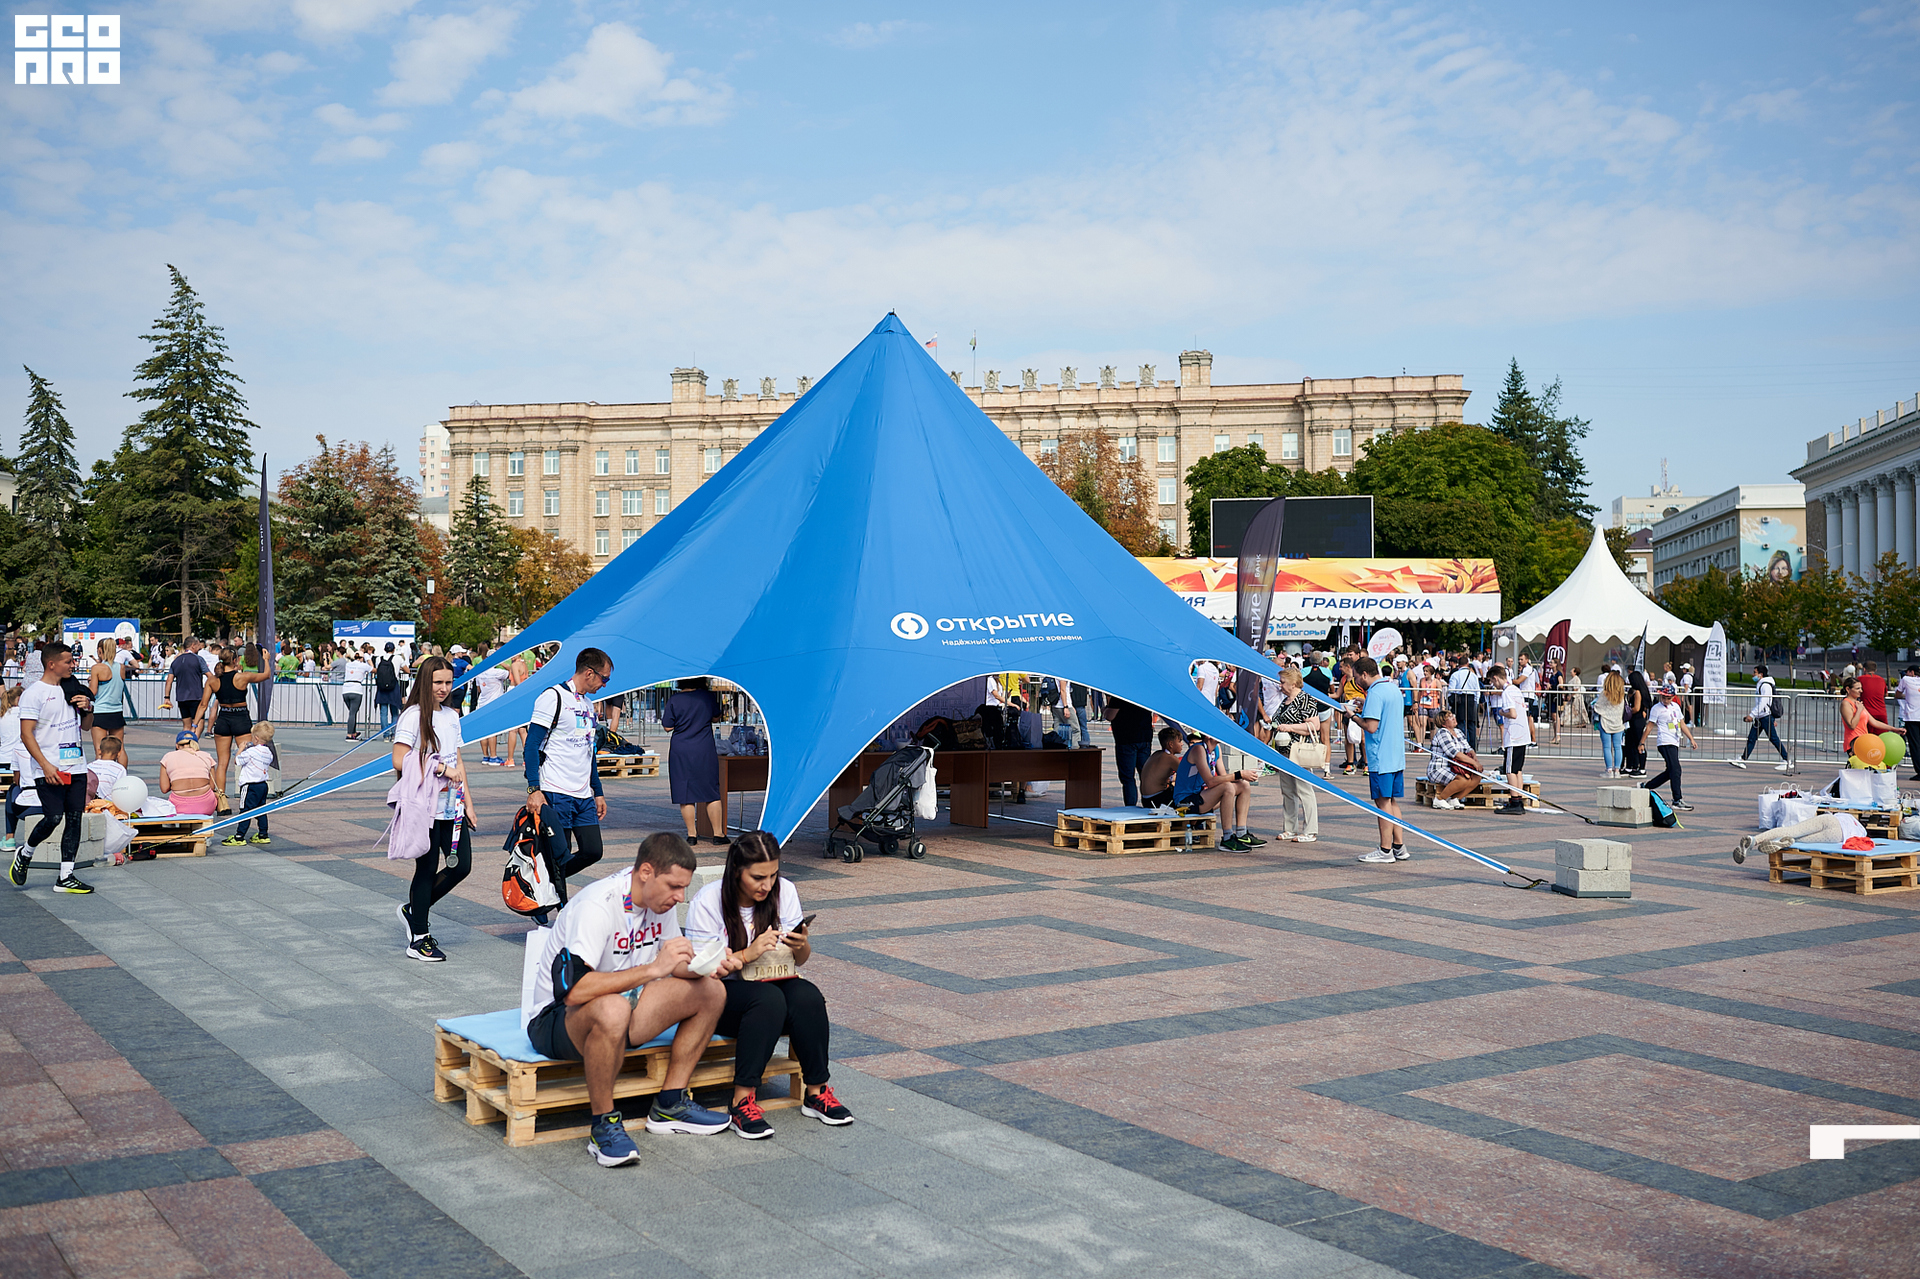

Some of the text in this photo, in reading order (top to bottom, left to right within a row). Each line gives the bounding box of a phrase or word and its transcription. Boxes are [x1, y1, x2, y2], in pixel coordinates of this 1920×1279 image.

[1254, 553, 1262, 578] БАНК
[1301, 597, 1433, 610] ГРАВИРОВКА
[935, 612, 1075, 635] открытие
[941, 634, 1083, 646] Надёжный банк нашего времени
